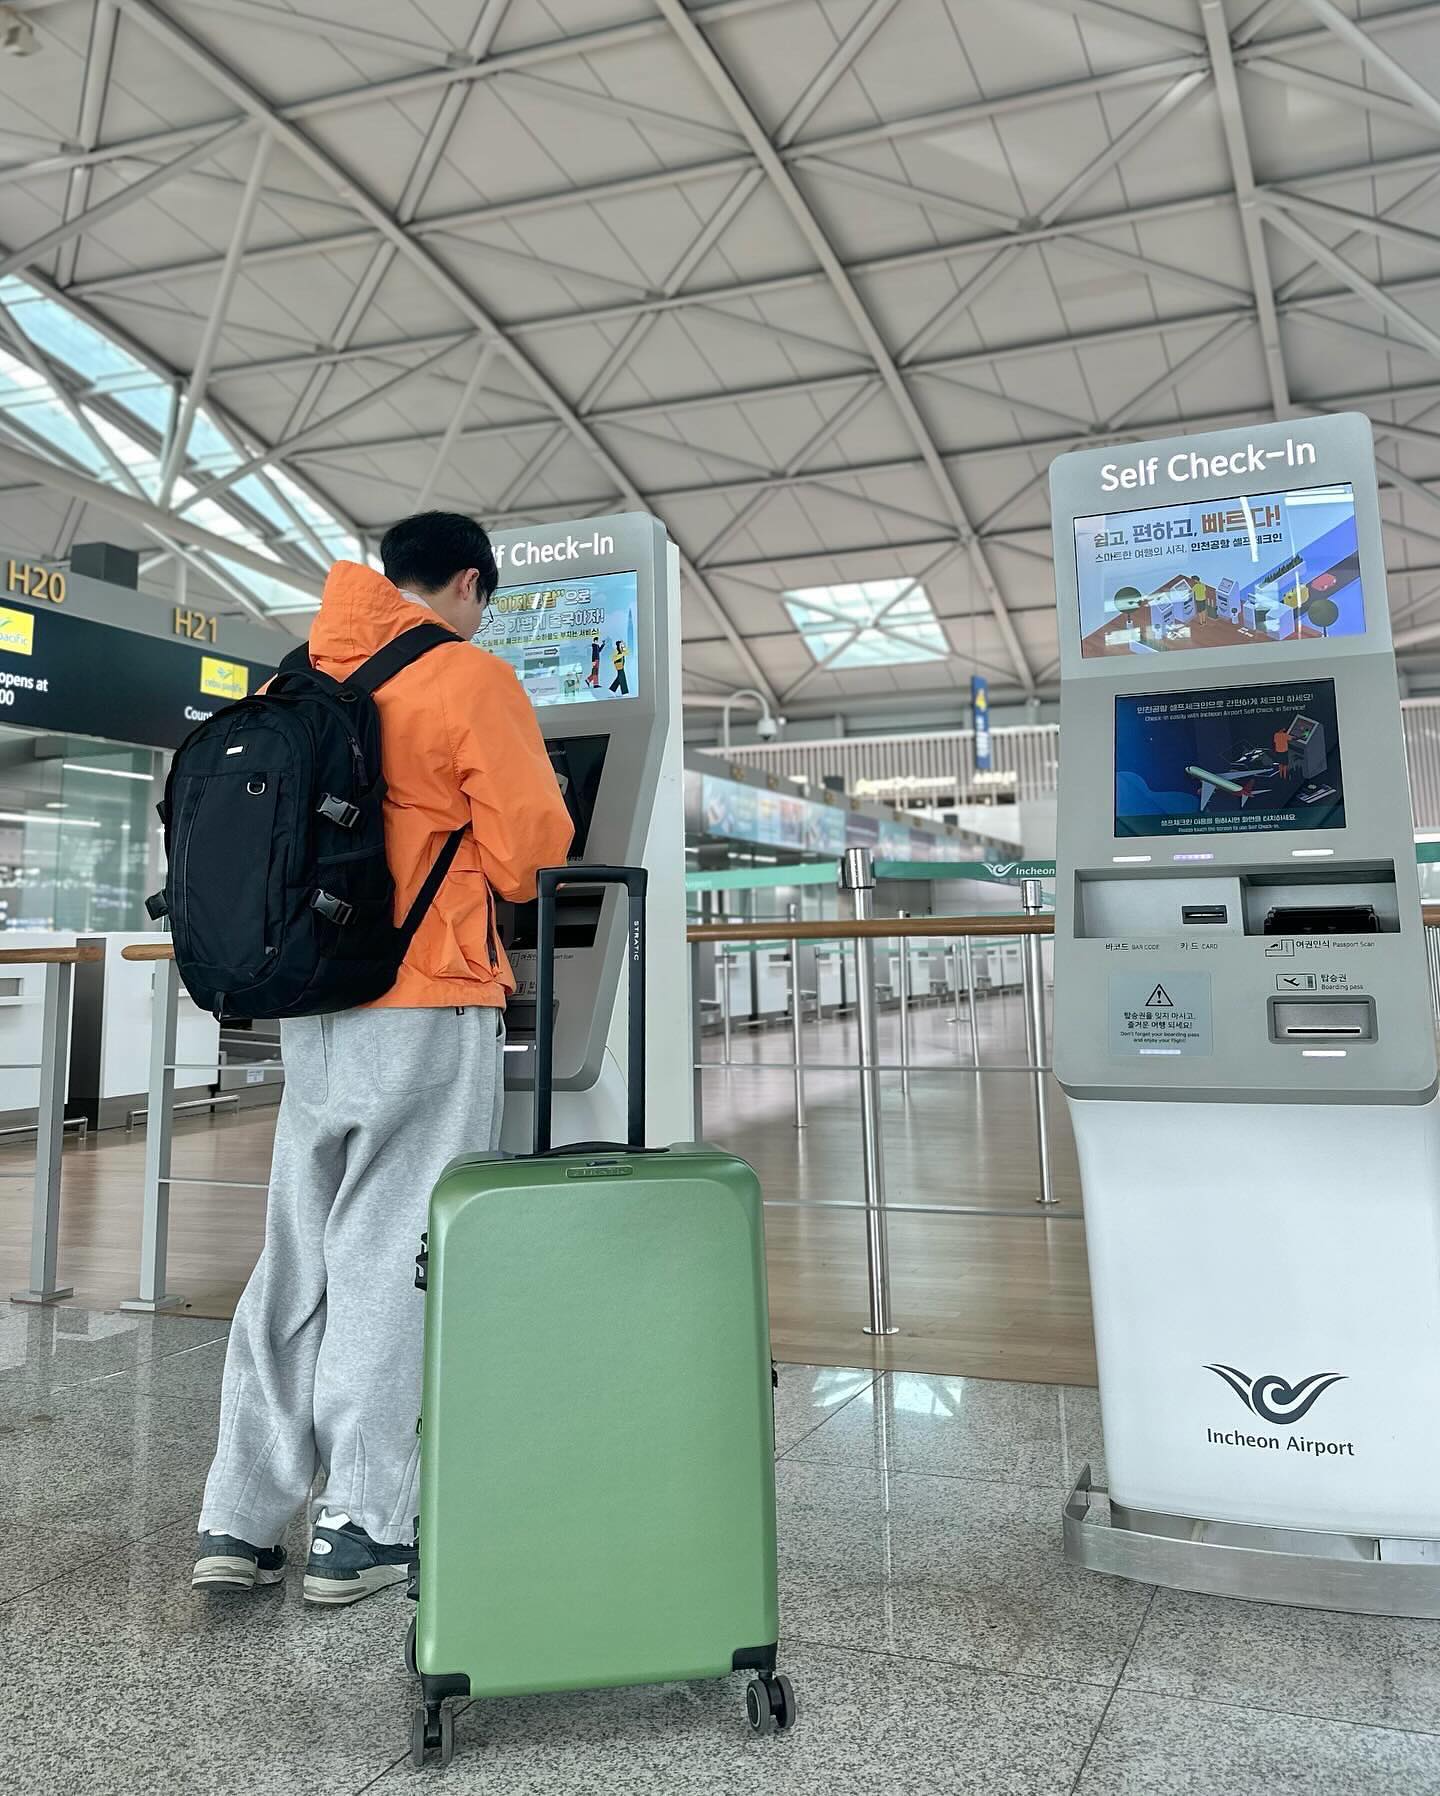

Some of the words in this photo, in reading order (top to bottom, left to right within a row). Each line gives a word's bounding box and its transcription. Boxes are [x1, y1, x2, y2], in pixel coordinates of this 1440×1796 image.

[1101, 455, 1160, 493] Self
[1167, 438, 1317, 483] Check-In
[1132, 518, 1198, 544] 편하고,
[1202, 504, 1281, 534] 빠르다!
[510, 532, 615, 568] Check-In
[1095, 550, 1132, 563] 스마트한
[1134, 546, 1163, 559] 여행의
[1190, 537, 1230, 552] 인천공항
[7, 559, 67, 604] H20
[173, 606, 218, 643] H21
[0, 672, 34, 689] opens
[36, 678, 48, 692] at
[1015, 866, 1056, 875] Incheon
[1105, 943, 1129, 952] 바코드
[1295, 940, 1331, 949] 여권인식
[1332, 941, 1359, 949] Passport
[1360, 940, 1376, 948] Scan
[1320, 973, 1347, 983] 탑승권
[1321, 983, 1349, 991] Boarding
[1124, 1011, 1153, 1020] 탑승권을
[1154, 1011, 1170, 1020] 잊지
[1127, 1020, 1150, 1029] 즐거운
[1151, 1020, 1166, 1029] 여행
[1206, 1427, 1280, 1450] Incheon
[1286, 1435, 1355, 1457] Airport
